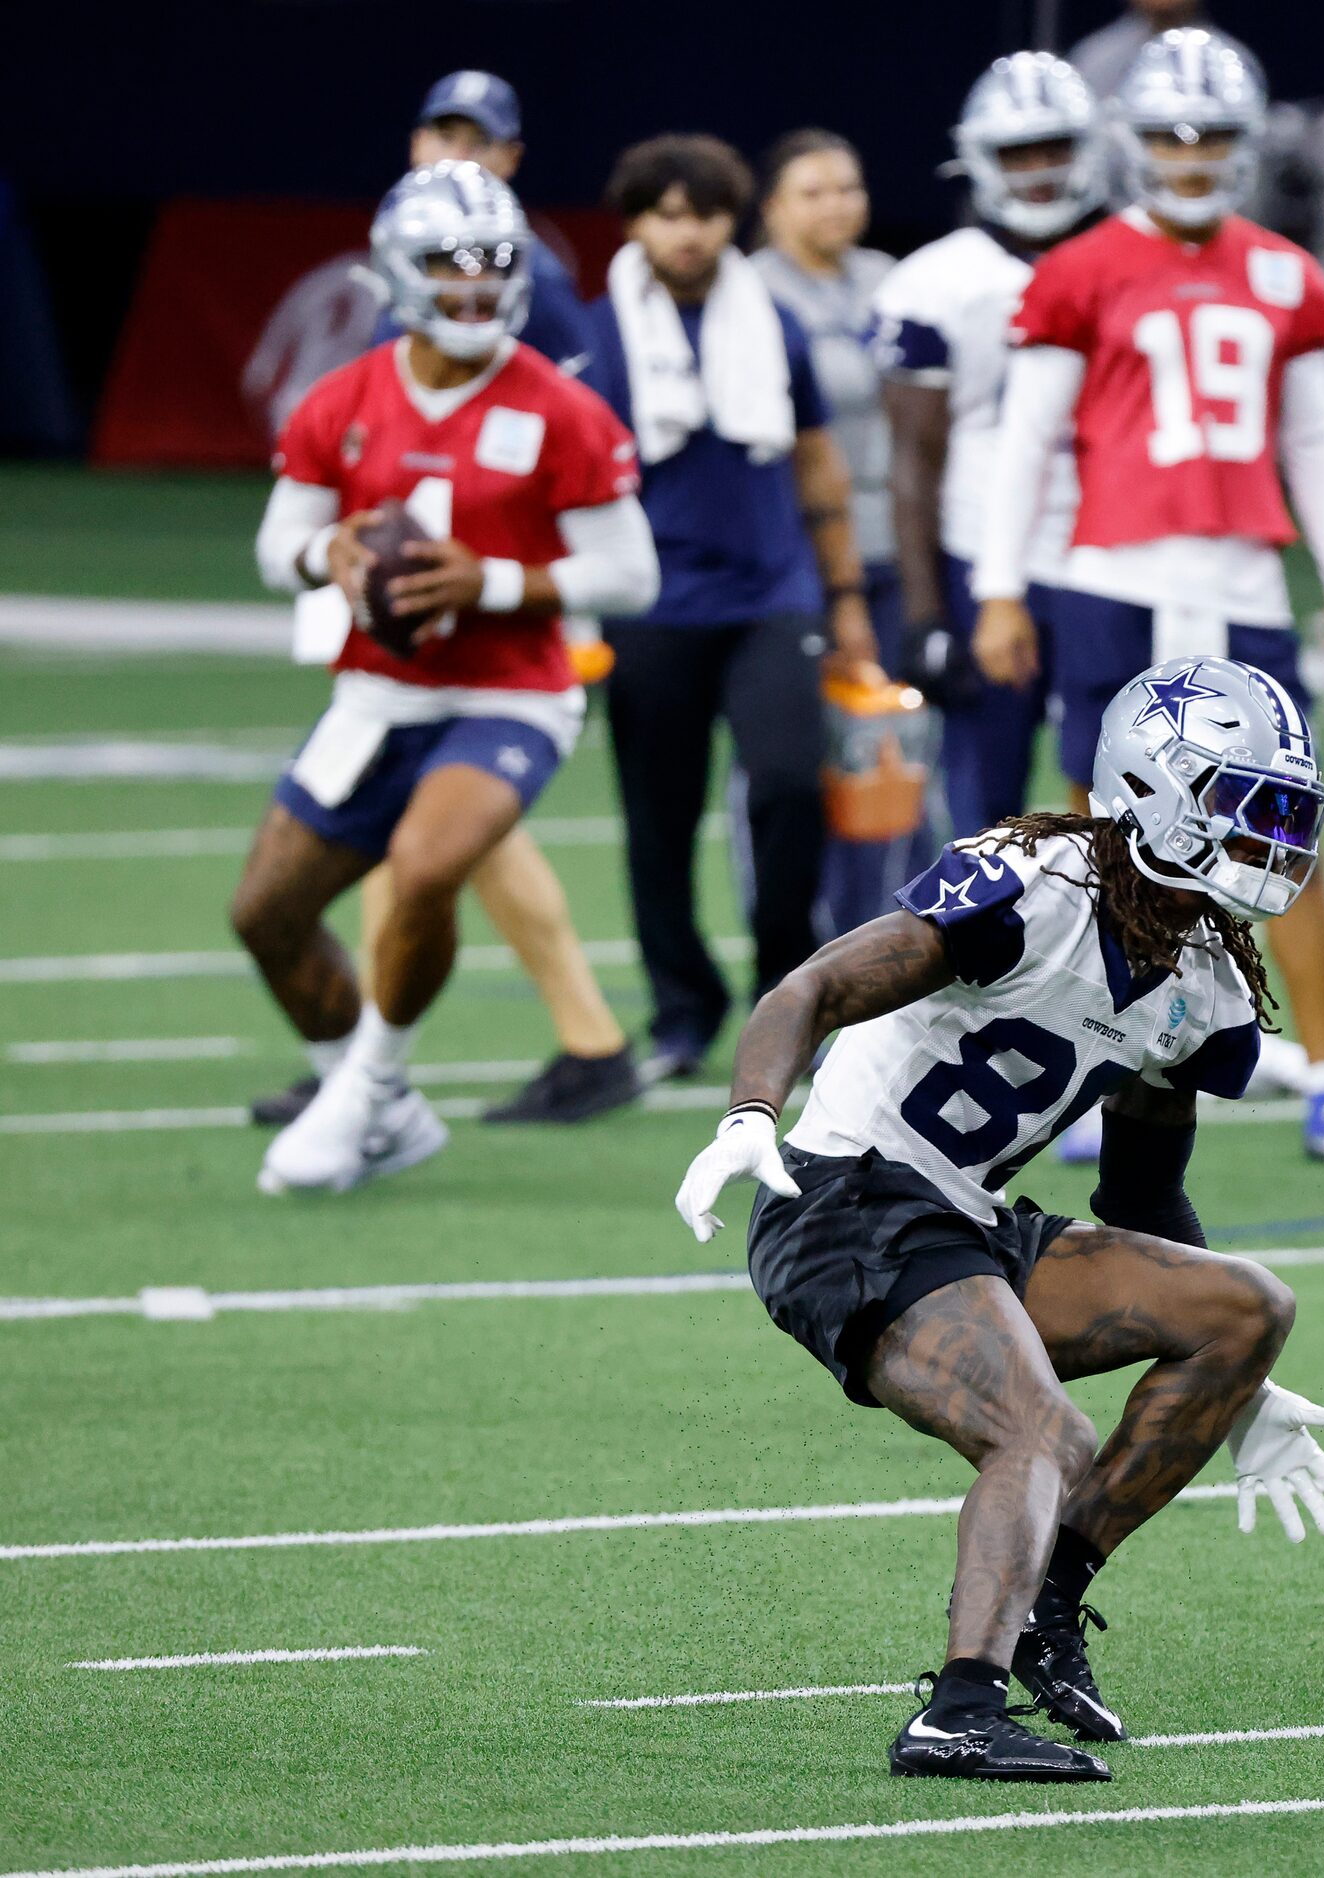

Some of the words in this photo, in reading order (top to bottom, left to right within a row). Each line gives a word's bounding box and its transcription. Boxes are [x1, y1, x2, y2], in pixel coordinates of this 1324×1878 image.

[1132, 303, 1276, 468] 19
[1081, 1017, 1127, 1043] COWBOYS
[1157, 1031, 1177, 1049] AT&T
